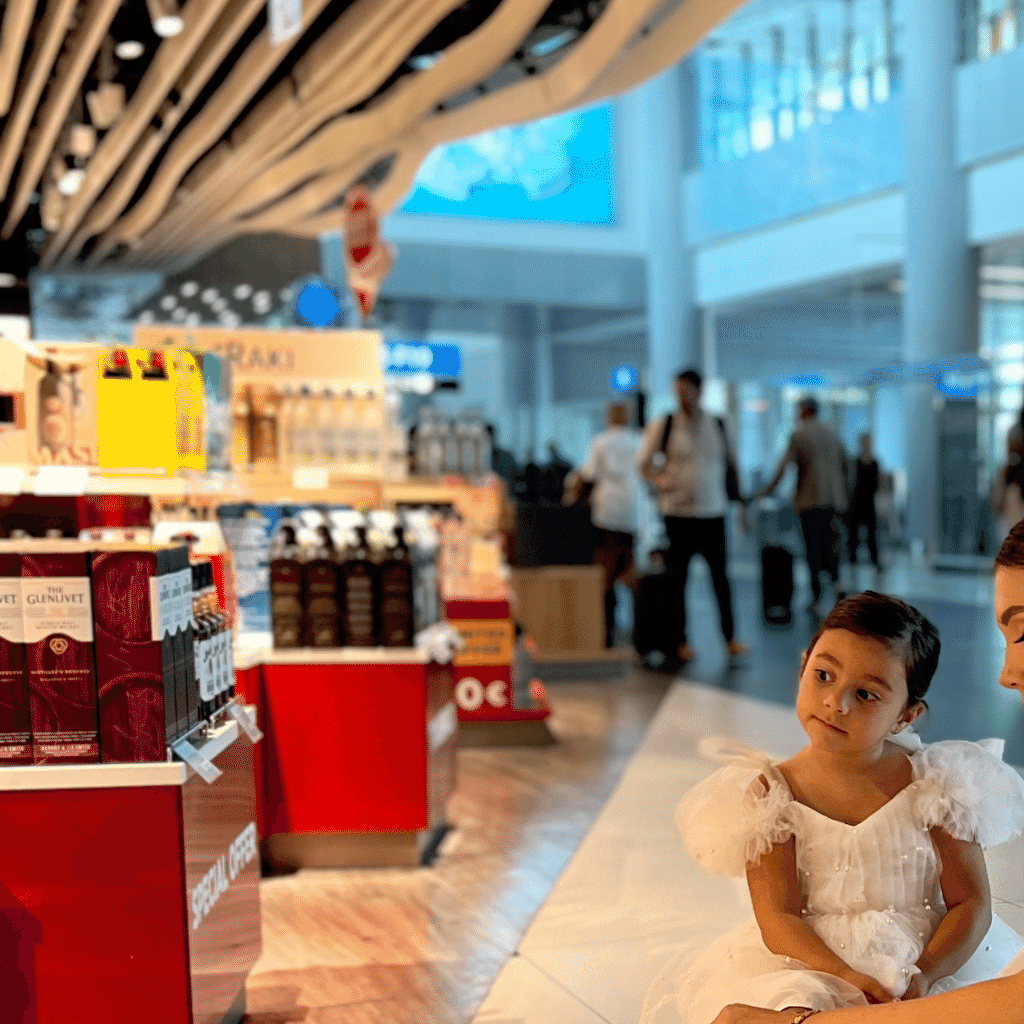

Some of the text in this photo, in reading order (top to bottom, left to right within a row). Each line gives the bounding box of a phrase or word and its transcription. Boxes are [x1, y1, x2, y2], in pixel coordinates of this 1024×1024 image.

[27, 594, 84, 605] GLENLIVET
[191, 821, 258, 931] SPECIAL OFFER
